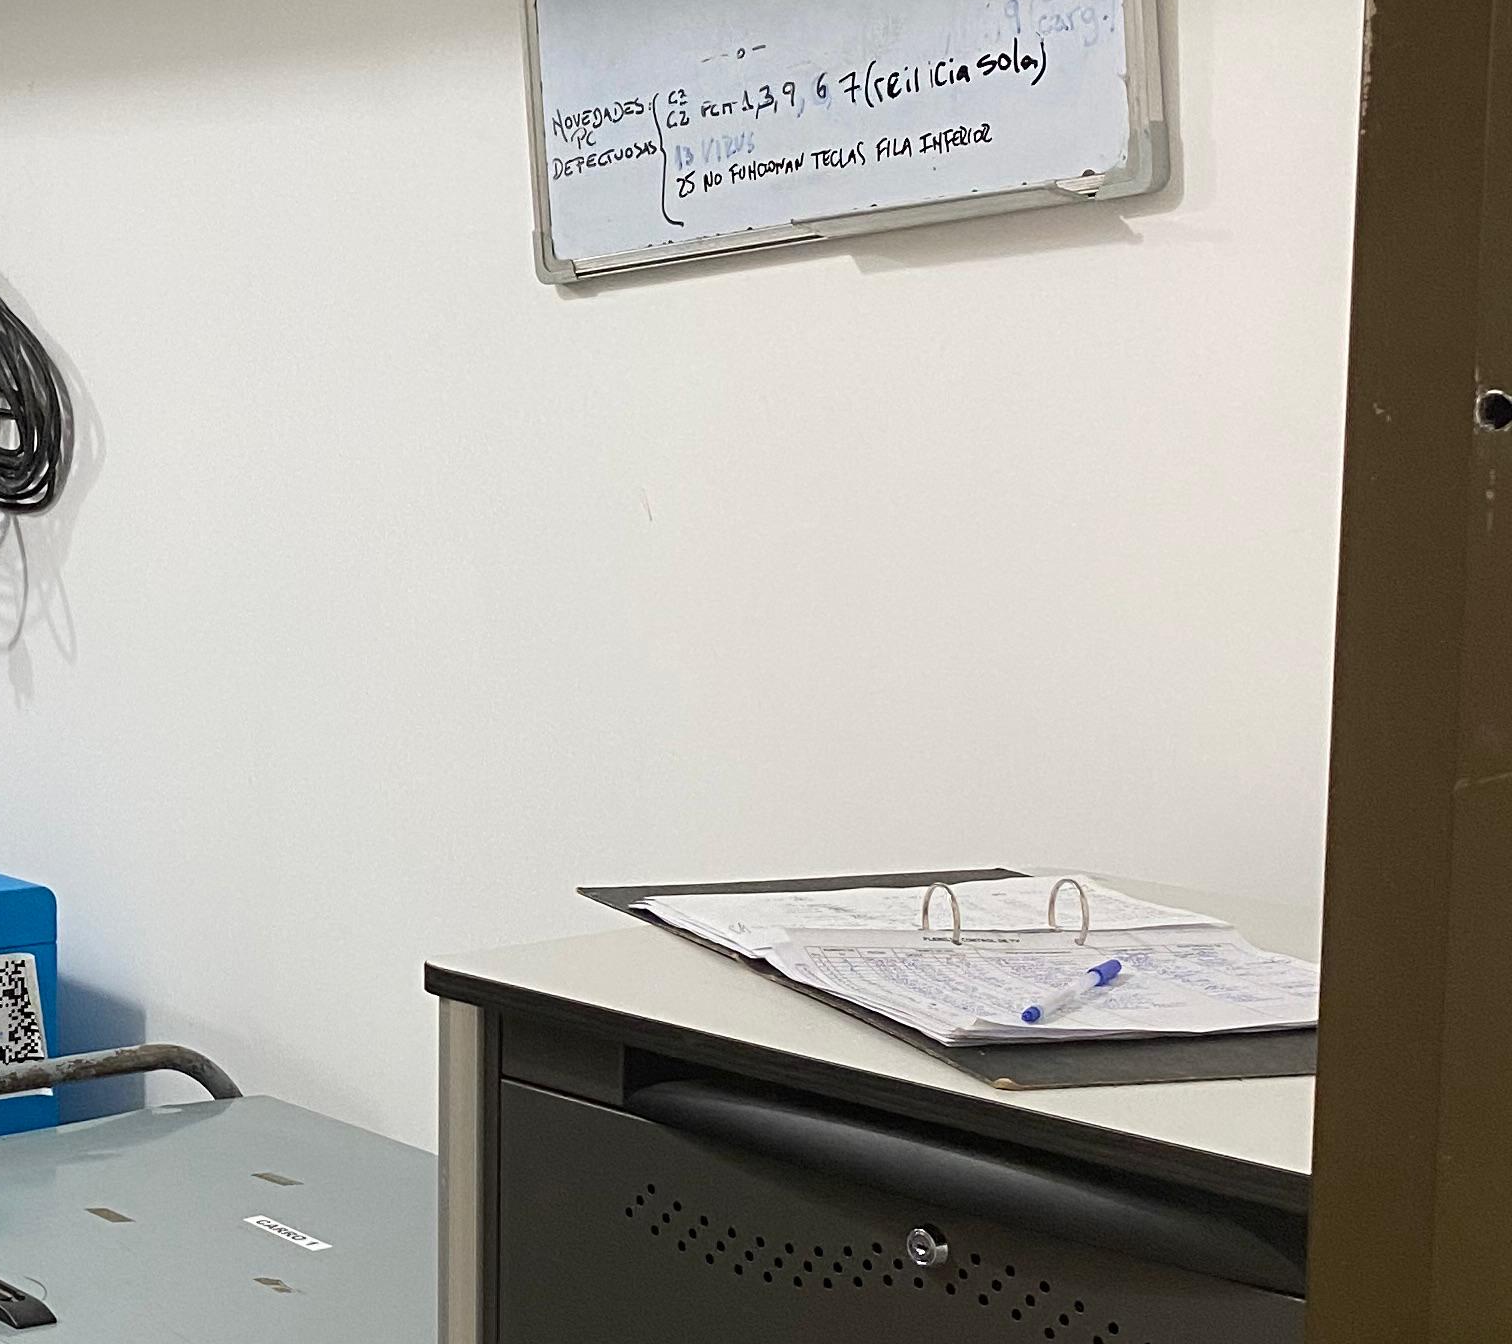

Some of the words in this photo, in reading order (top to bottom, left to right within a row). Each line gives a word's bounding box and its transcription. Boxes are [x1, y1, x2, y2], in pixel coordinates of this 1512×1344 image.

[571, 127, 597, 150] PC
[704, 170, 723, 193] NO
[811, 141, 866, 171] TECLAS
[876, 136, 912, 162] FILA
[919, 123, 993, 155] INFERIOR
[256, 1220, 306, 1240] CARRO
